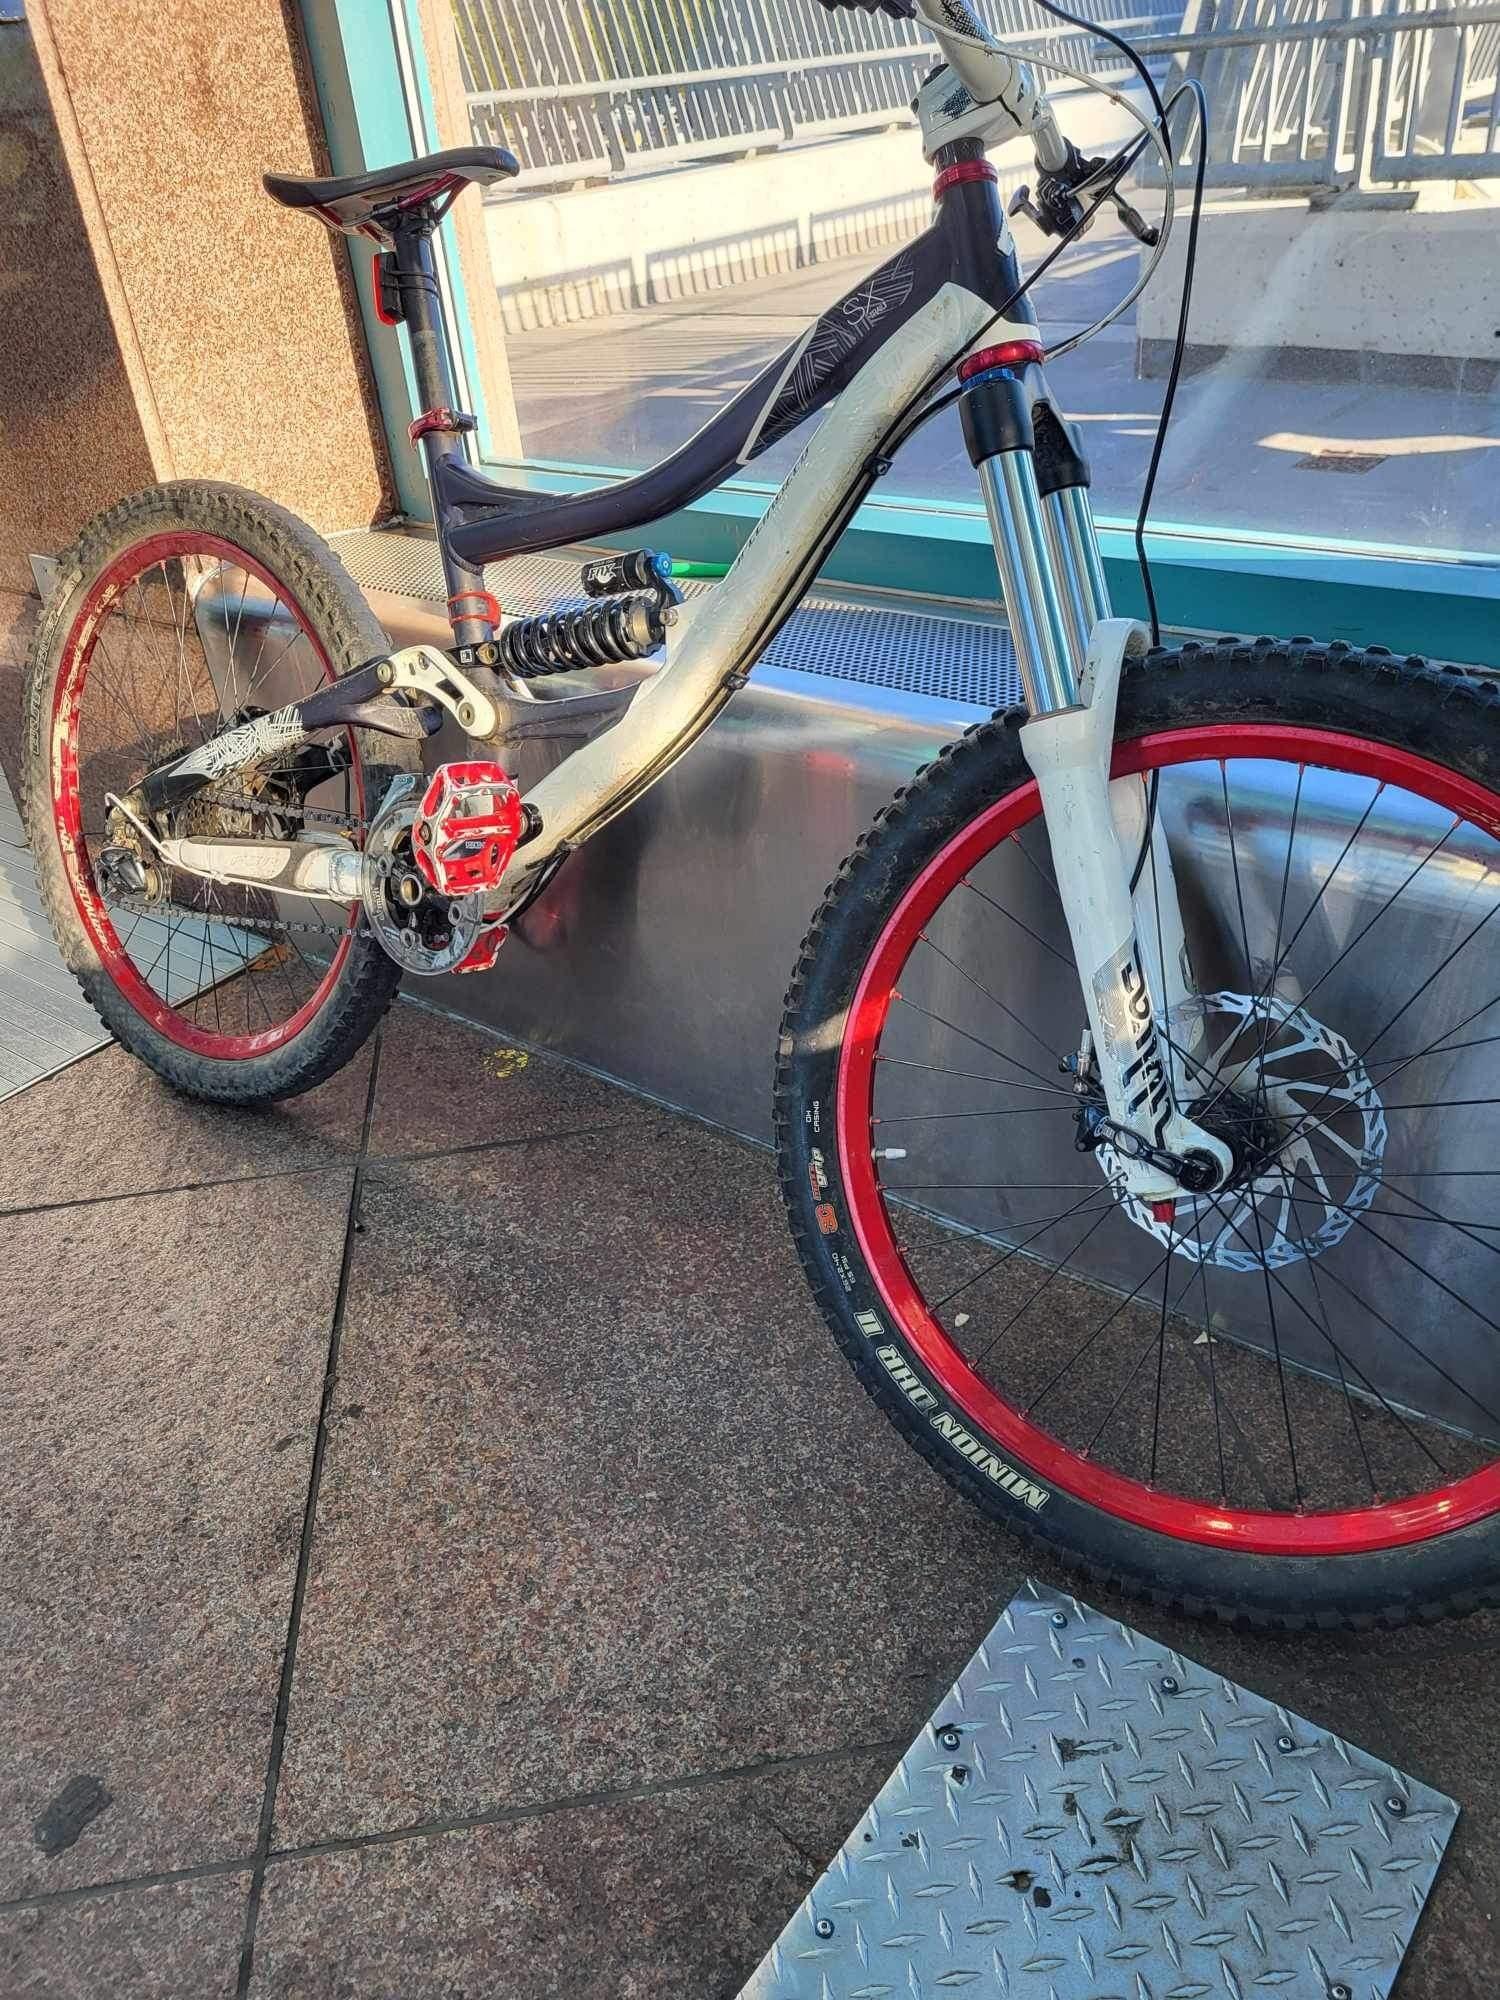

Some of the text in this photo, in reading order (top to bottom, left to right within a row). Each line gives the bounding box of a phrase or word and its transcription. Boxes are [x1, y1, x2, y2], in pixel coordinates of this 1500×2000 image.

[842, 280, 884, 326] SX
[587, 563, 616, 582] FOX
[805, 1110, 812, 1122] DH
[854, 1308, 1049, 1509] MINION DHR II
